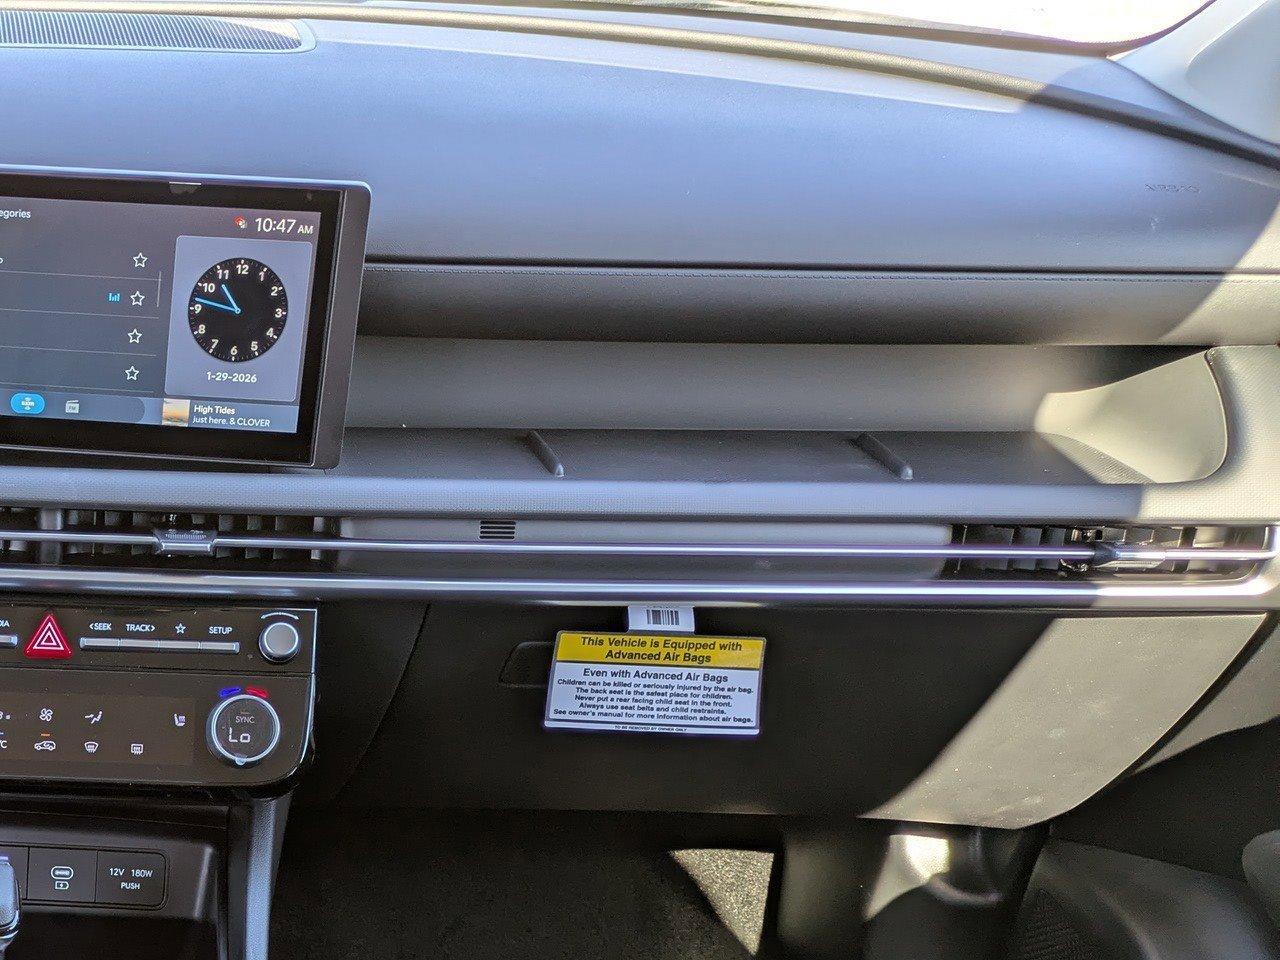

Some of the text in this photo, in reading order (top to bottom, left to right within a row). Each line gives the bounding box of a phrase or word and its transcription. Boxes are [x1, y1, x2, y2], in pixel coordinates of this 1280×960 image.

[255, 218, 314, 235] 10:47 AM
[217, 269, 229, 280] 11
[236, 265, 249, 275] 12
[259, 272, 265, 282] 1
[202, 283, 215, 293] 10
[271, 286, 278, 296] 2
[194, 304, 202, 314] 9
[275, 308, 282, 318] 3
[198, 324, 206, 334] 8
[266, 327, 274, 338] 4
[211, 339, 219, 349] 7
[251, 341, 258, 351] 5
[230, 345, 238, 355] 6
[206, 371, 257, 383] 1-29-2026
[193, 405, 236, 415] High Tides
[192, 416, 271, 427] just here. & CLOVER
[209, 626, 233, 635] SETUP
[581, 636, 743, 651] This Vehicle is Equipped with
[605, 650, 712, 664] Advanced Air Bags
[583, 668, 729, 684] Even with Advanced Air Bags
[557, 678, 586, 686] Children
[613, 680, 632, 688] killed
[642, 683, 675, 691] seriously
[676, 683, 702, 692] injured
[703, 685, 712, 693] by
[738, 686, 754, 694] bag.
[596, 695, 609, 703] put
[631, 697, 653, 705] facing
[669, 691, 689, 699] place
[579, 702, 604, 710] Always
[690, 707, 727, 715] restraints.
[235, 715, 255, 724] SYNC
[657, 713, 698, 721] information
[109, 867, 153, 878] 12V 180W
[120, 882, 141, 890] PUSH
